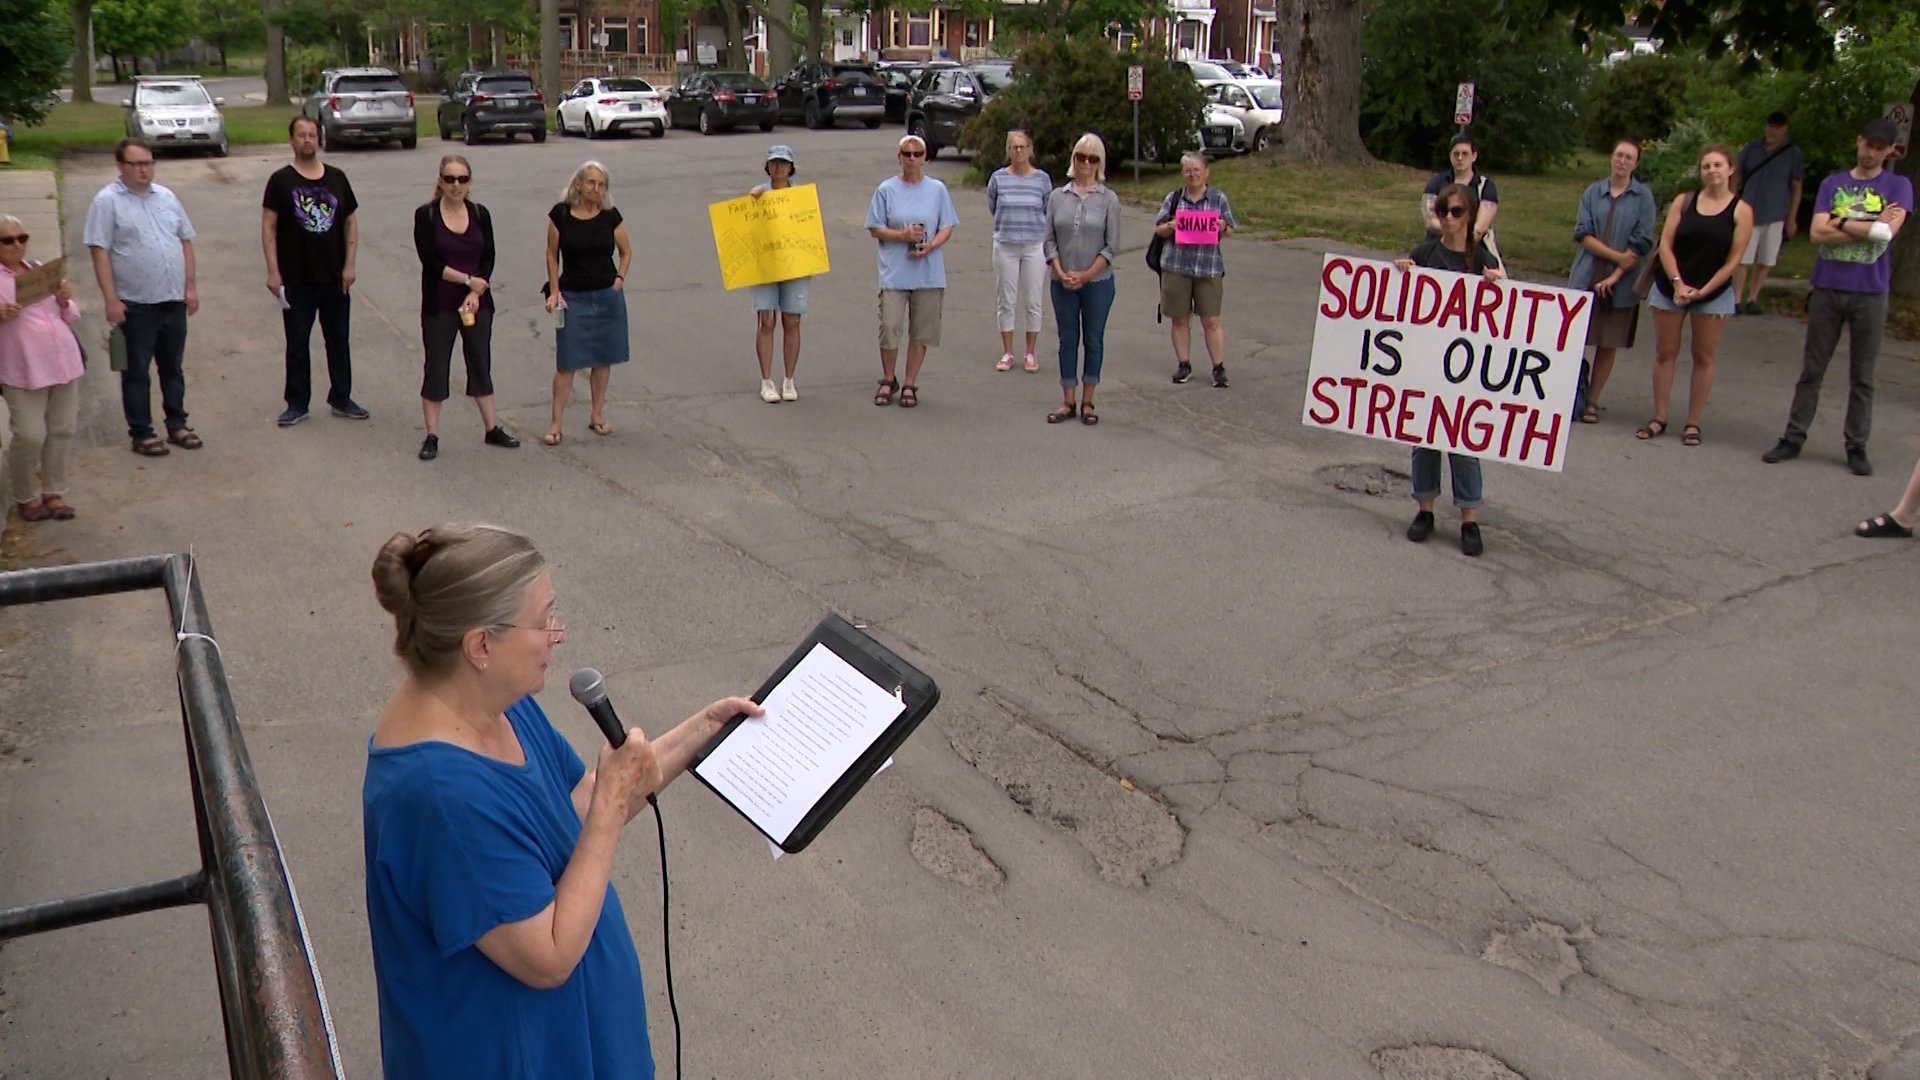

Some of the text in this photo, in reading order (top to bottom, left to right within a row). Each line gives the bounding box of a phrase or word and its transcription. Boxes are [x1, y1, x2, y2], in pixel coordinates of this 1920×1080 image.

[1320, 258, 1588, 351] SOLIDARITY
[1360, 329, 1551, 400] IS OUR
[1309, 376, 1562, 467] STRENGTH
